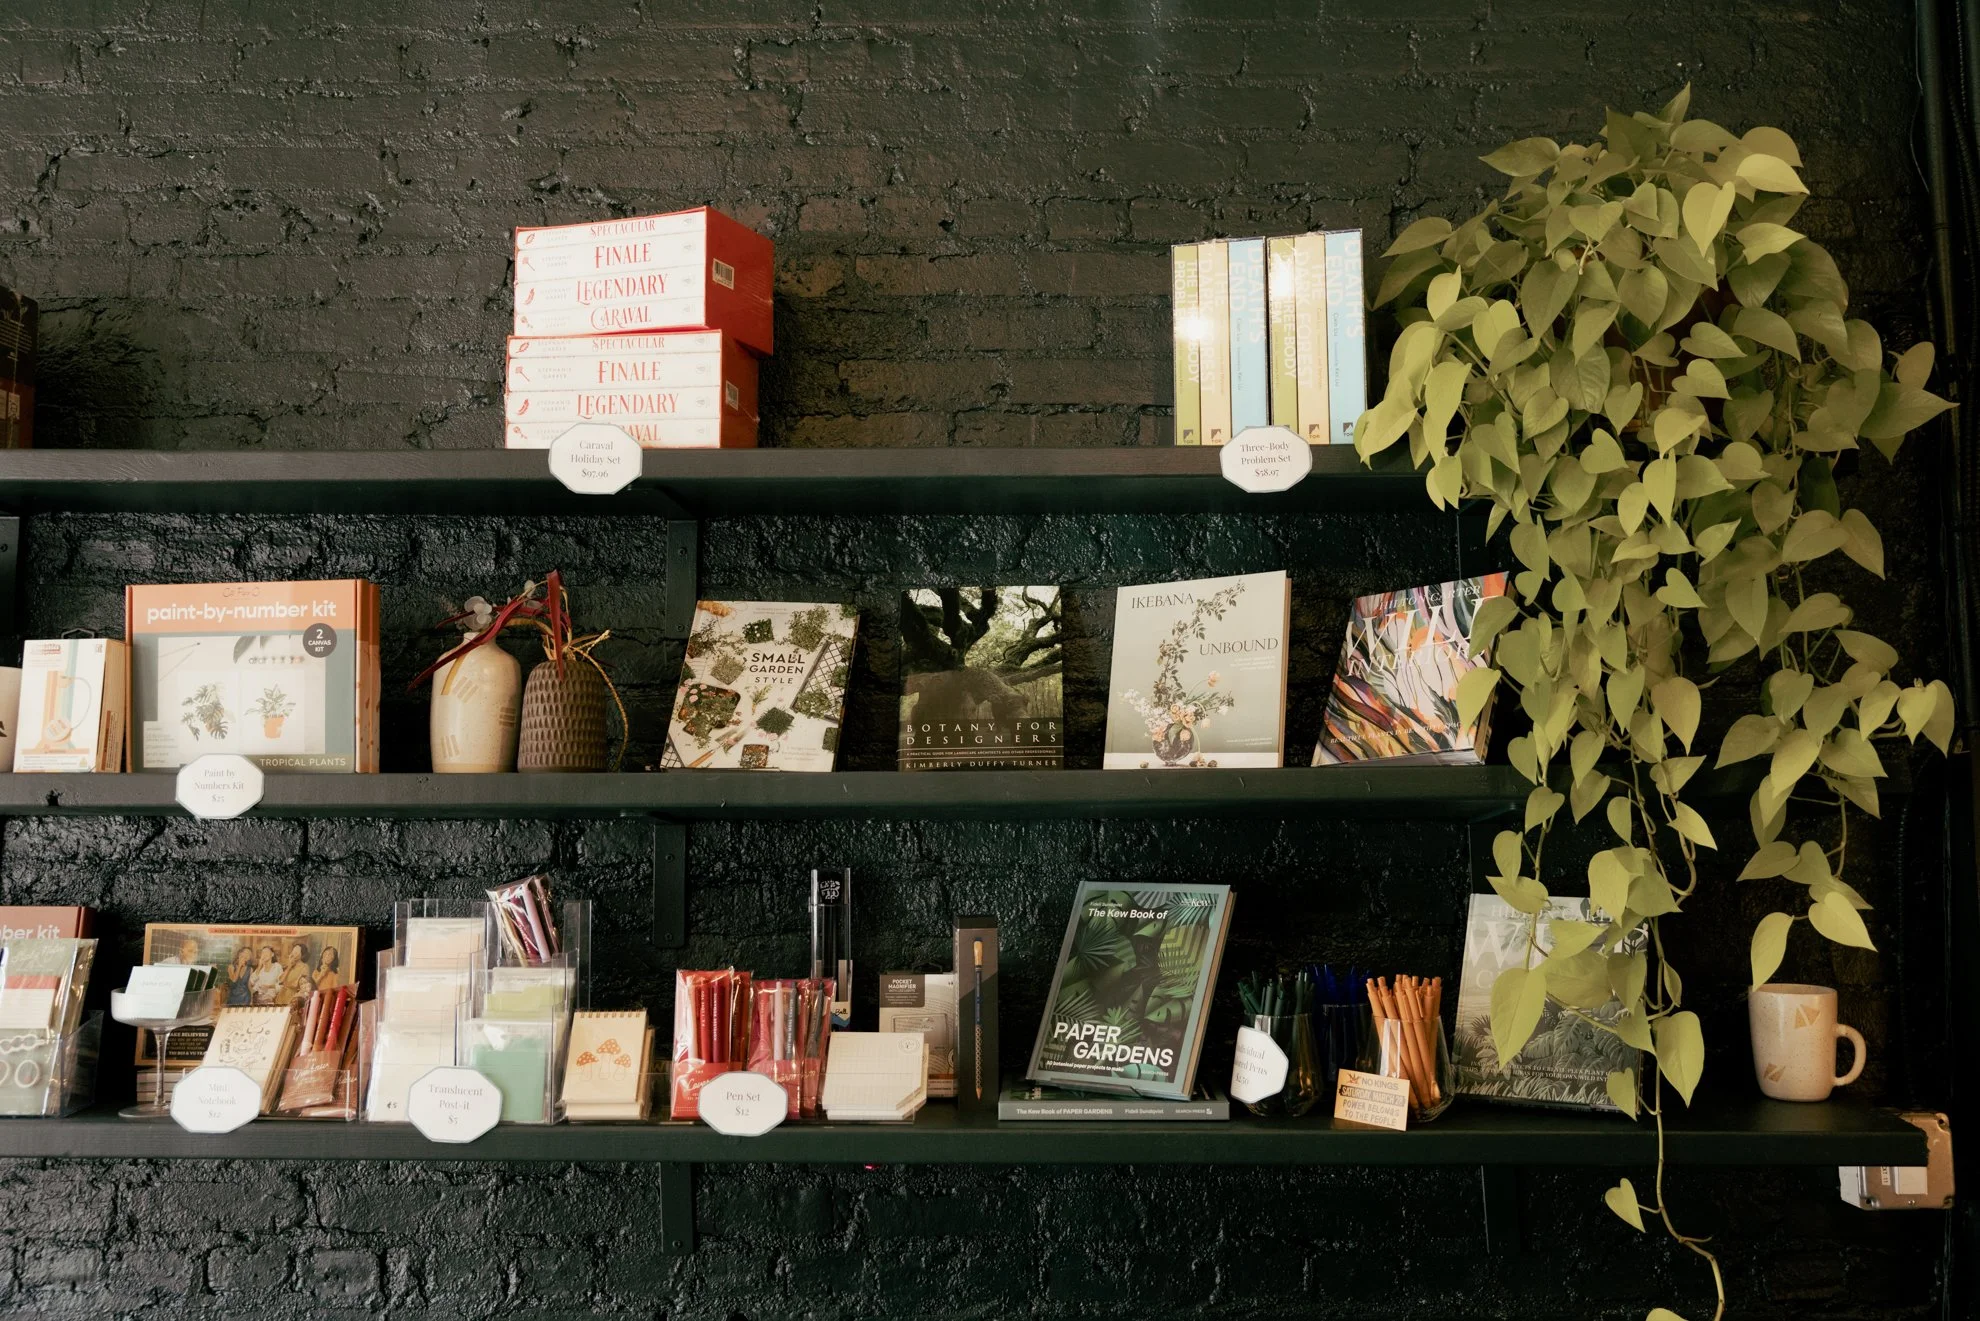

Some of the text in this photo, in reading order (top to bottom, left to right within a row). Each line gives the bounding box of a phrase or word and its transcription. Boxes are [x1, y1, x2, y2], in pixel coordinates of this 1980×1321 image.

[590, 219, 656, 237] SPECTACULAR
[594, 242, 652, 268] FINALE
[1187, 261, 1198, 286] THE
[1326, 254, 1342, 304] END
[576, 273, 668, 306] LEGENDARY
[1230, 262, 1246, 310] END
[1344, 240, 1362, 338] DEATH'S
[1247, 247, 1265, 344] DEATH'S
[590, 305, 652, 330] CARAVAL
[592, 336, 664, 352] SPECTACULAR
[598, 360, 661, 384] FINALE
[576, 393, 679, 420] LEGENDARY
[580, 440, 614, 450] Caraval
[1240, 441, 1290, 452] Three-Body
[570, 454, 621, 466] Holiday Set
[1241, 456, 1276, 464] Problem
[1131, 592, 1194, 609] IKEBANA
[147, 600, 337, 624] paint-by-number kit
[316, 628, 324, 640] 2
[1200, 638, 1279, 656] UNBOUND
[751, 652, 806, 664] SMALL
[750, 664, 804, 674] GARDEN
[754, 676, 794, 684] STYLE
[906, 722, 1057, 732] BOTANY FOR
[906, 734, 1056, 745] DESIGNERS
[260, 758, 346, 768] TROPICAL PLANTS
[204, 769, 236, 778] Paint by
[194, 781, 244, 790] Numbers Kit
[1089, 908, 1168, 919] The Kew Book of
[37, 924, 60, 939] kit
[1054, 1022, 1122, 1044] PAPER
[1073, 1041, 1174, 1066] GARDENS
[430, 1084, 483, 1096] Translucent
[1362, 1078, 1400, 1090] NO KINGS
[198, 1095, 237, 1106] Notebook
[726, 1091, 760, 1101] Pen Set
[440, 1100, 470, 1110] Post-it
[1343, 1099, 1366, 1110] POWER
[735, 1107, 750, 1116] $12
[1345, 1110, 1397, 1126] TO THE PEOPLE
